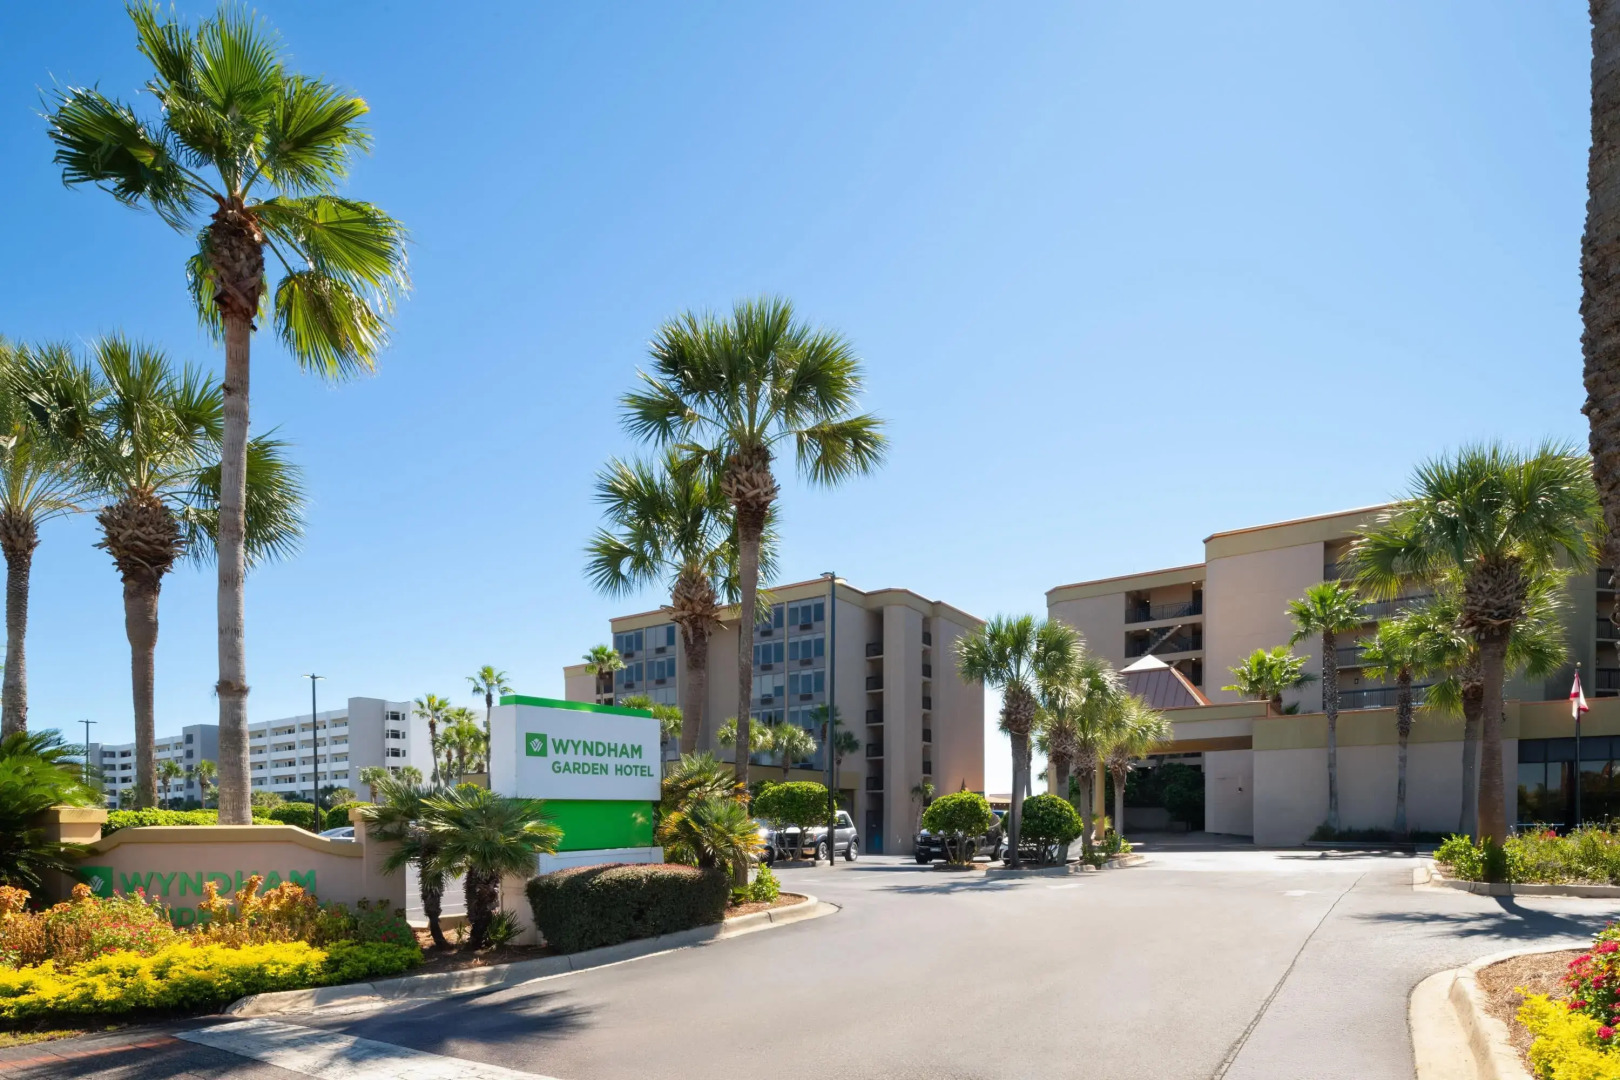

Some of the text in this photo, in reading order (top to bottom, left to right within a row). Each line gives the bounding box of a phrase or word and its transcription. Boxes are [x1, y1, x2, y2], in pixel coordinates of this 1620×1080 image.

[551, 738, 643, 759] WYNDHAM
[551, 760, 654, 777] GARDEN HOTEL
